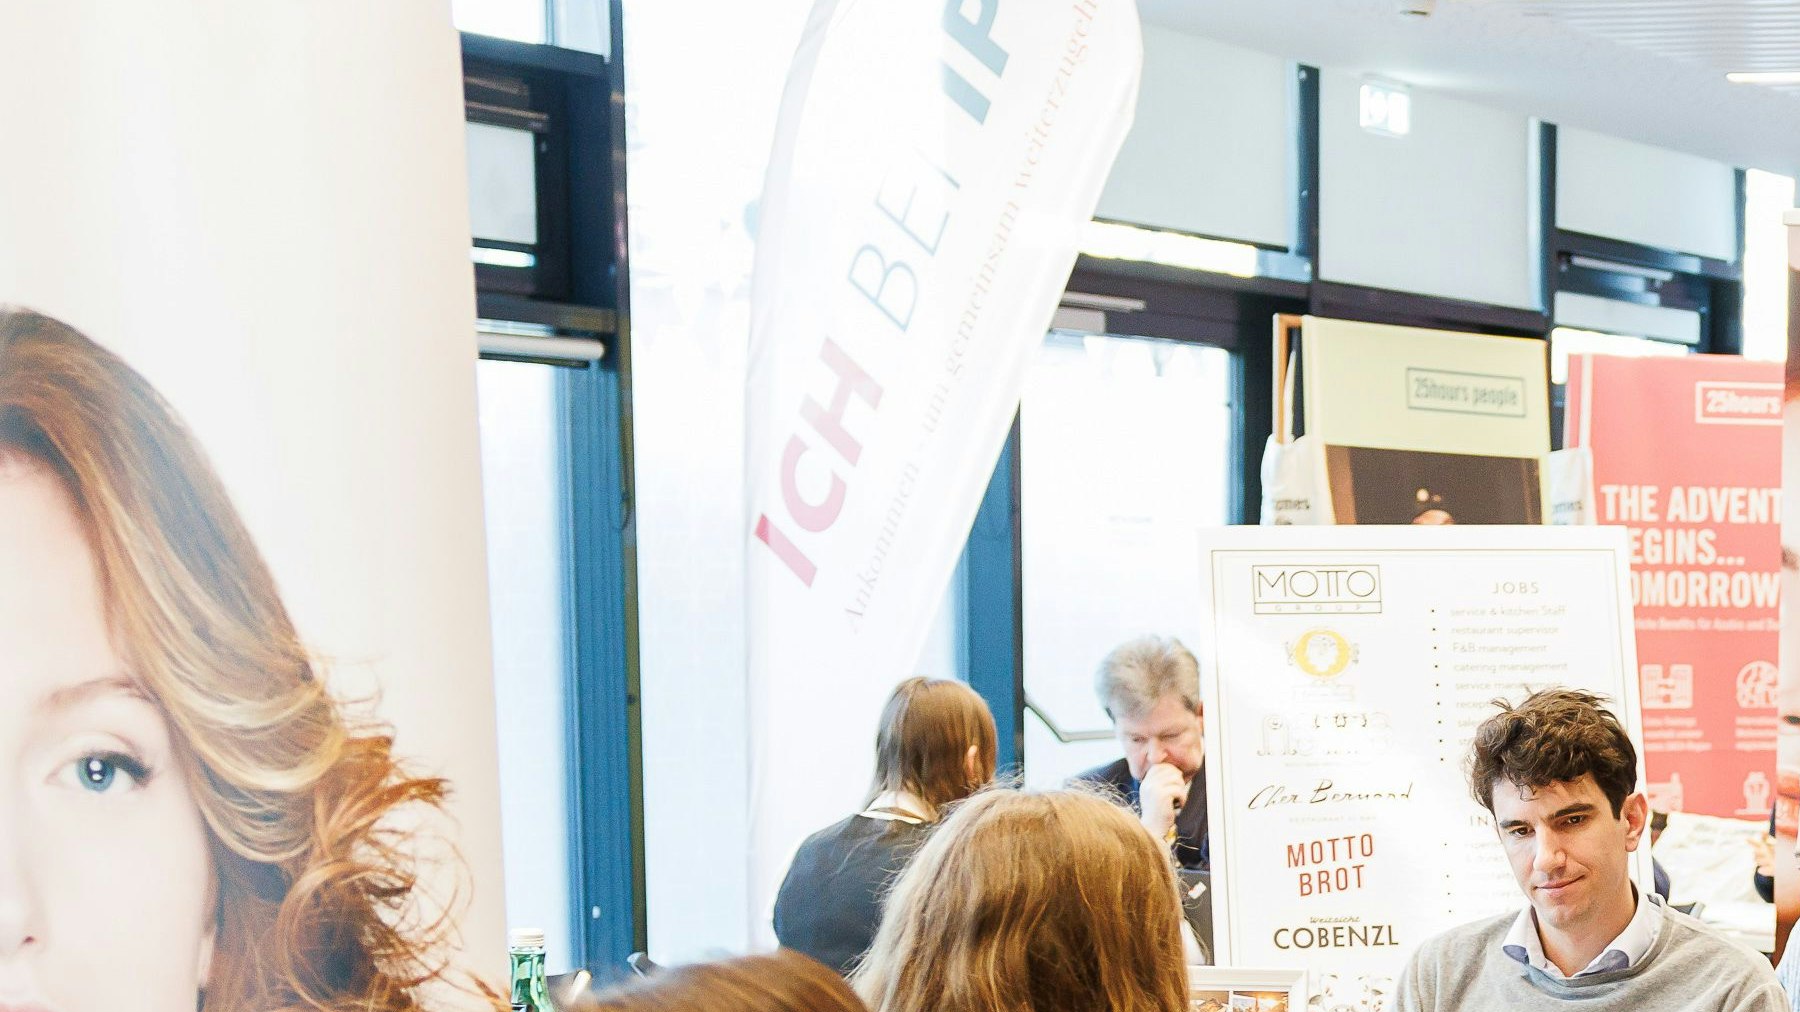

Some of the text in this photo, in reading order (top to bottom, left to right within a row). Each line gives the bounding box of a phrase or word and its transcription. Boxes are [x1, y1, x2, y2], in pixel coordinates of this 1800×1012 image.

[754, 336, 884, 590] ICH
[846, 144, 962, 333] BEI
[843, 458, 922, 636] Ankommen
[918, 376, 952, 436] um
[945, 199, 1022, 380] gemeinsam
[1600, 484, 1659, 522] THE
[1256, 569, 1377, 599] MOTTO
[1491, 581, 1540, 595] JOBS
[1285, 832, 1376, 869] MOTTO
[1298, 865, 1367, 898] BROT
[1273, 924, 1400, 951] COBENZL
